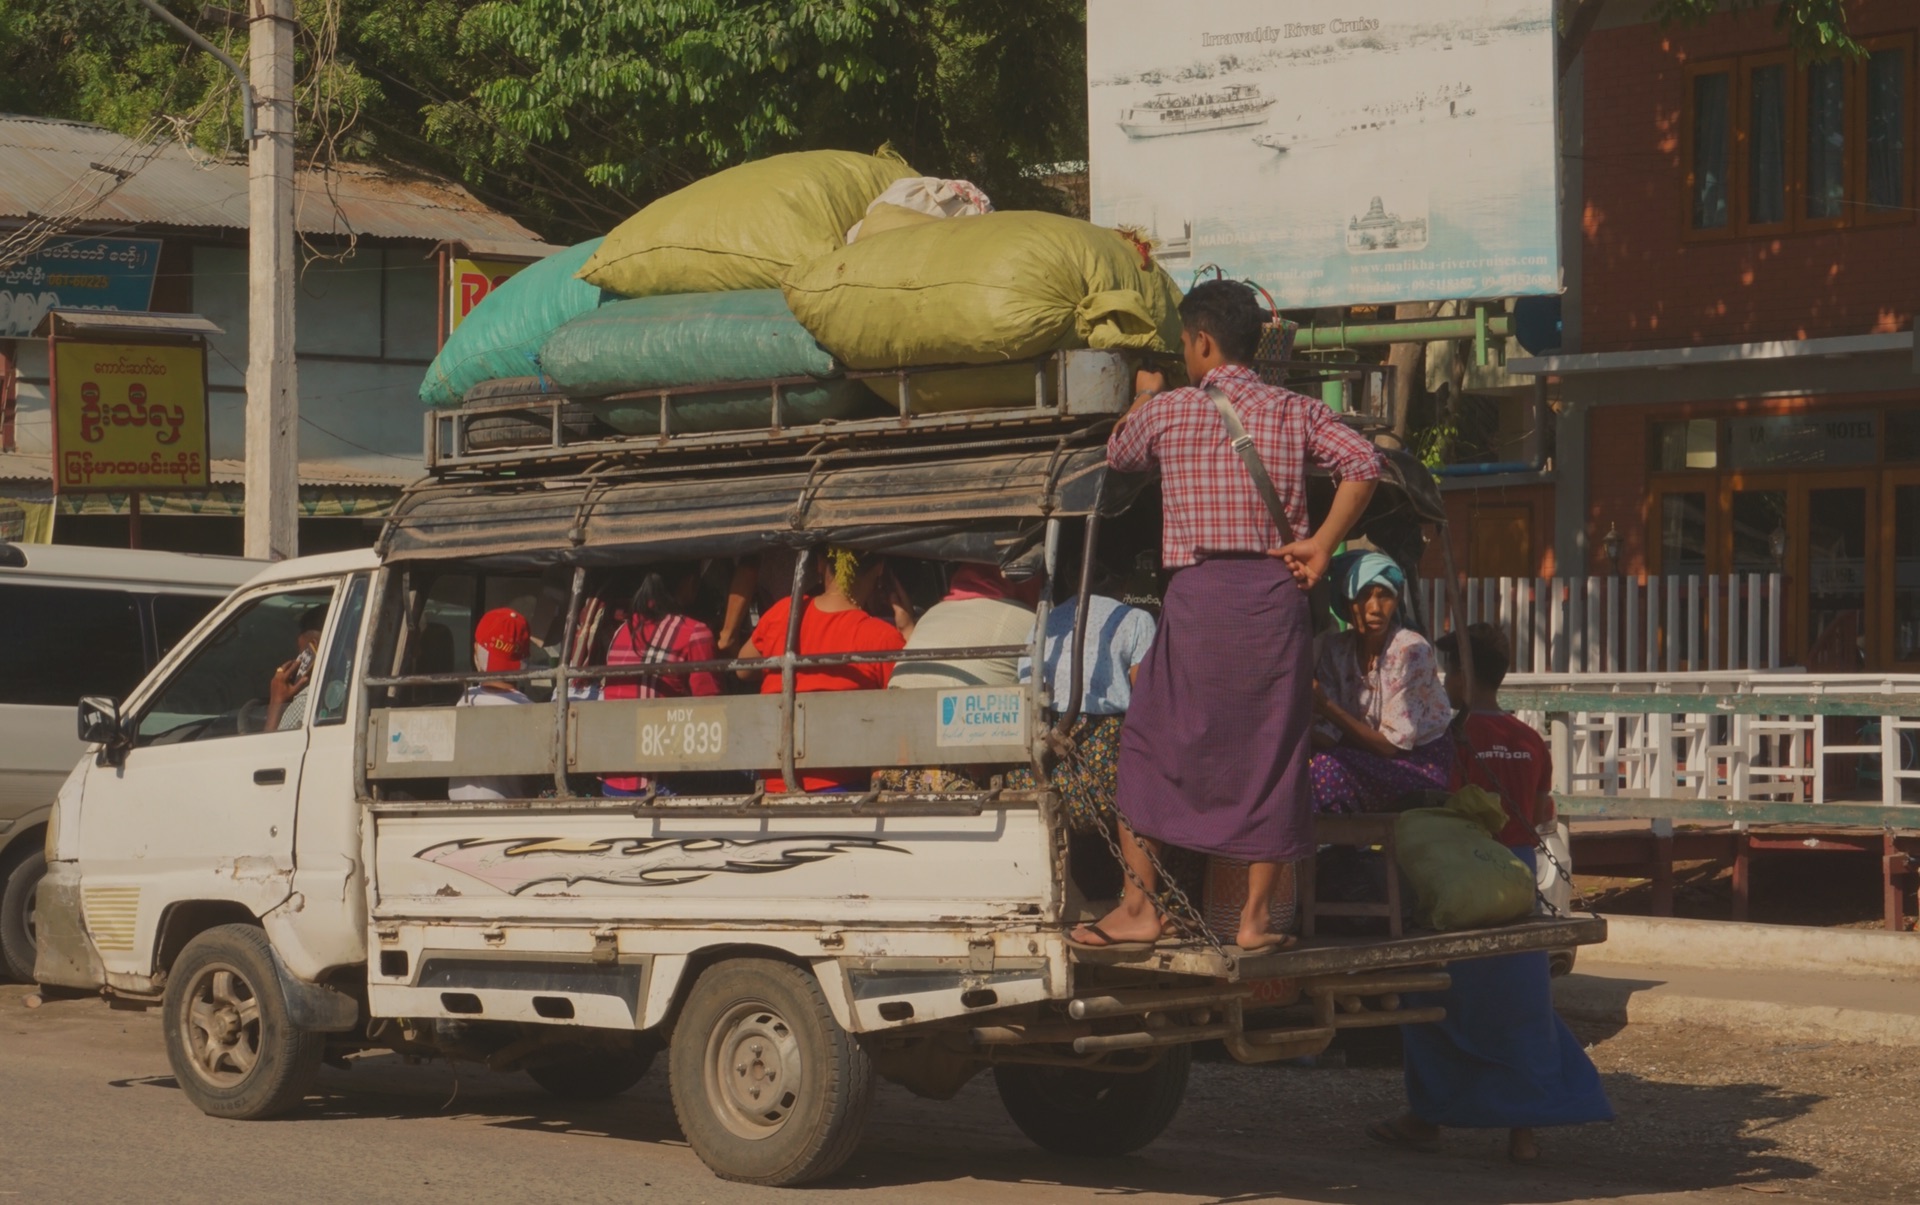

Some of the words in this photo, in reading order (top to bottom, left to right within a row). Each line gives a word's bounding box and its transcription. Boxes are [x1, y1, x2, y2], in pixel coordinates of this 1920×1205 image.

[1202, 27, 1280, 47] Irrawaddy
[1284, 22, 1326, 38] River
[1329, 16, 1379, 34] Cruise
[1350, 254, 1548, 275] www.malikha-rivercruises.com
[47, 273, 110, 289] 061-60225
[64, 450, 201, 484] မြန်မာထမင်းဆိုင်
[965, 694, 1019, 712] ALPHA
[667, 709, 694, 723] MDY
[965, 712, 1019, 725] CEMENT
